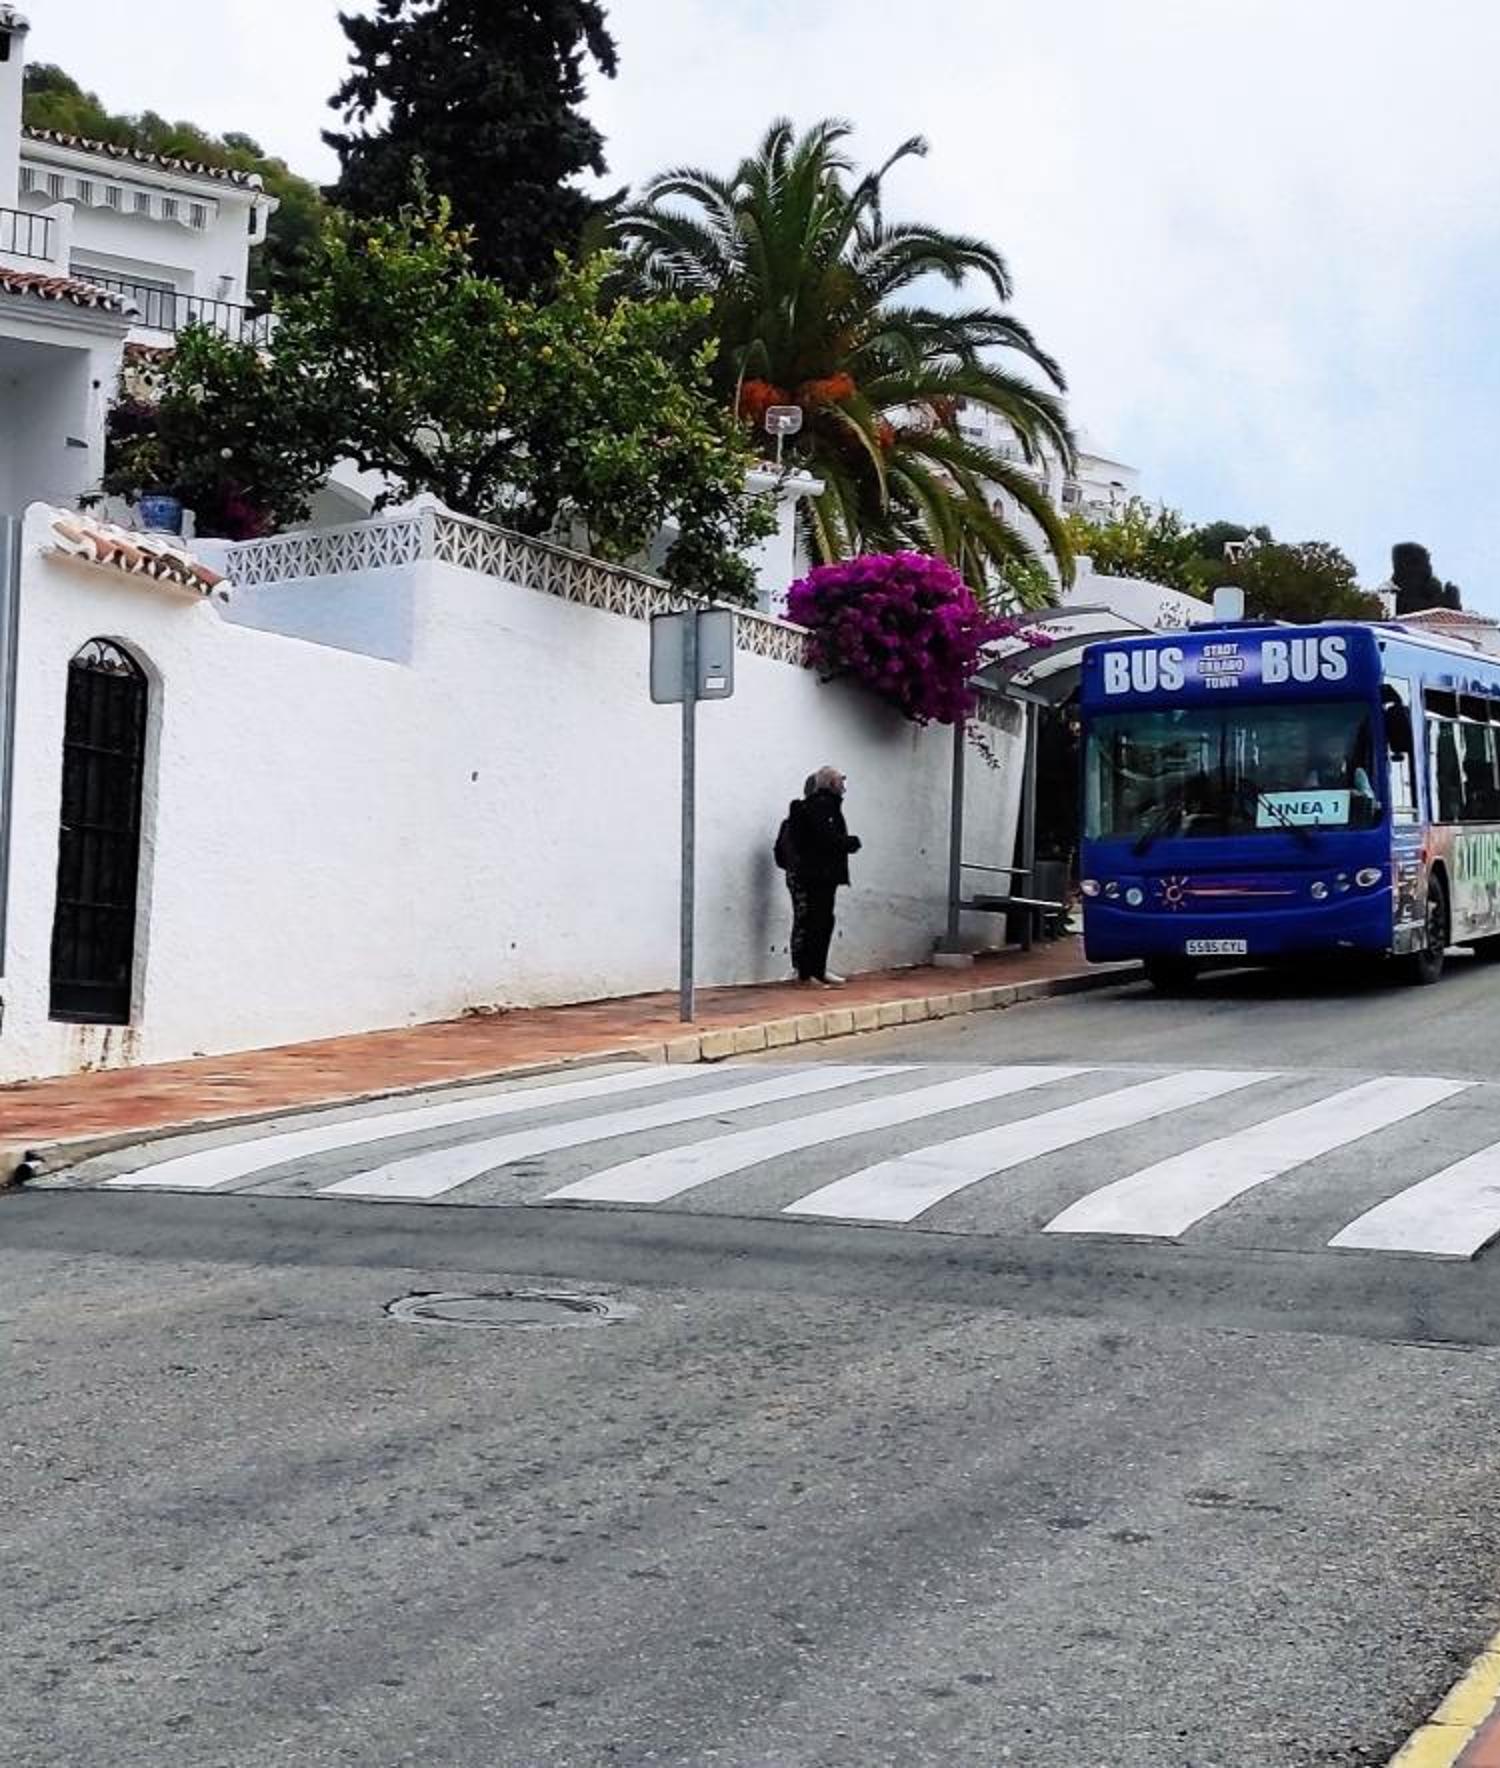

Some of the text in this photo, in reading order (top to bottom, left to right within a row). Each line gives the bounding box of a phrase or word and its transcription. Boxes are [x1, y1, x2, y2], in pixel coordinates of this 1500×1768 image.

[1103, 647, 1185, 695] BUS
[1261, 636, 1348, 684] BUS
[1205, 676, 1239, 689] TOWN
[1332, 801, 1339, 812] 1
